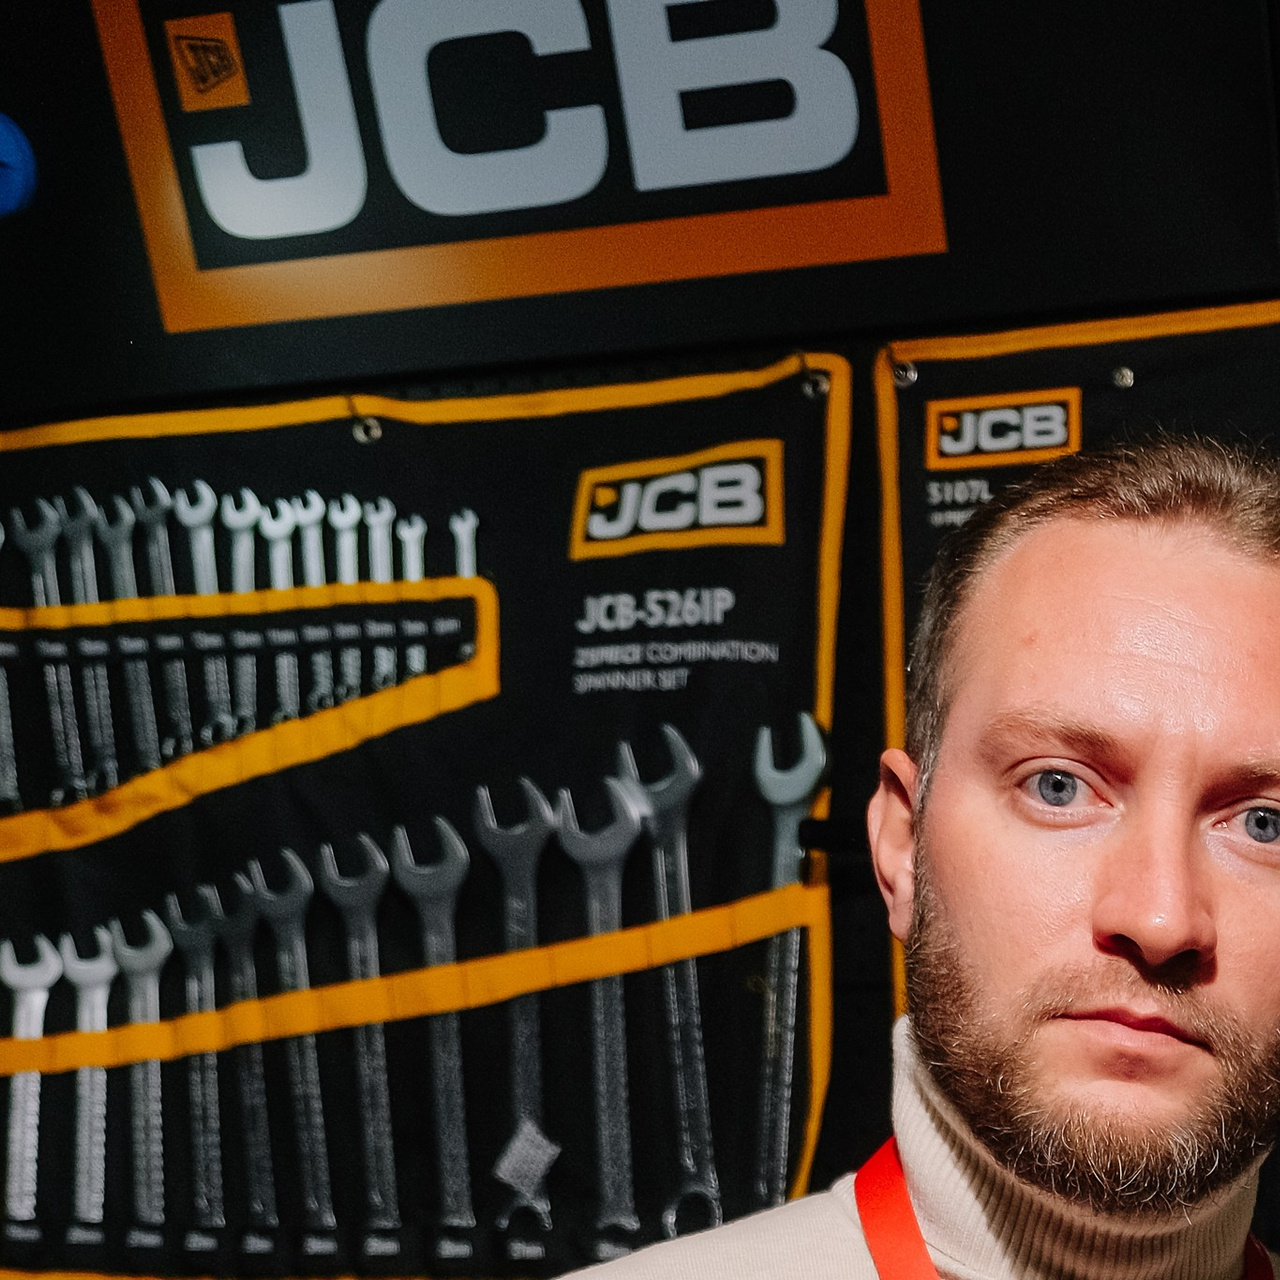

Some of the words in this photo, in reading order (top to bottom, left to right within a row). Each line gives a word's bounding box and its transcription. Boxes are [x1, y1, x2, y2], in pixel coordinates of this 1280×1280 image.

[192, 0, 860, 240] JCB
[939, 404, 1068, 456] JCB
[586, 463, 765, 540] JCB
